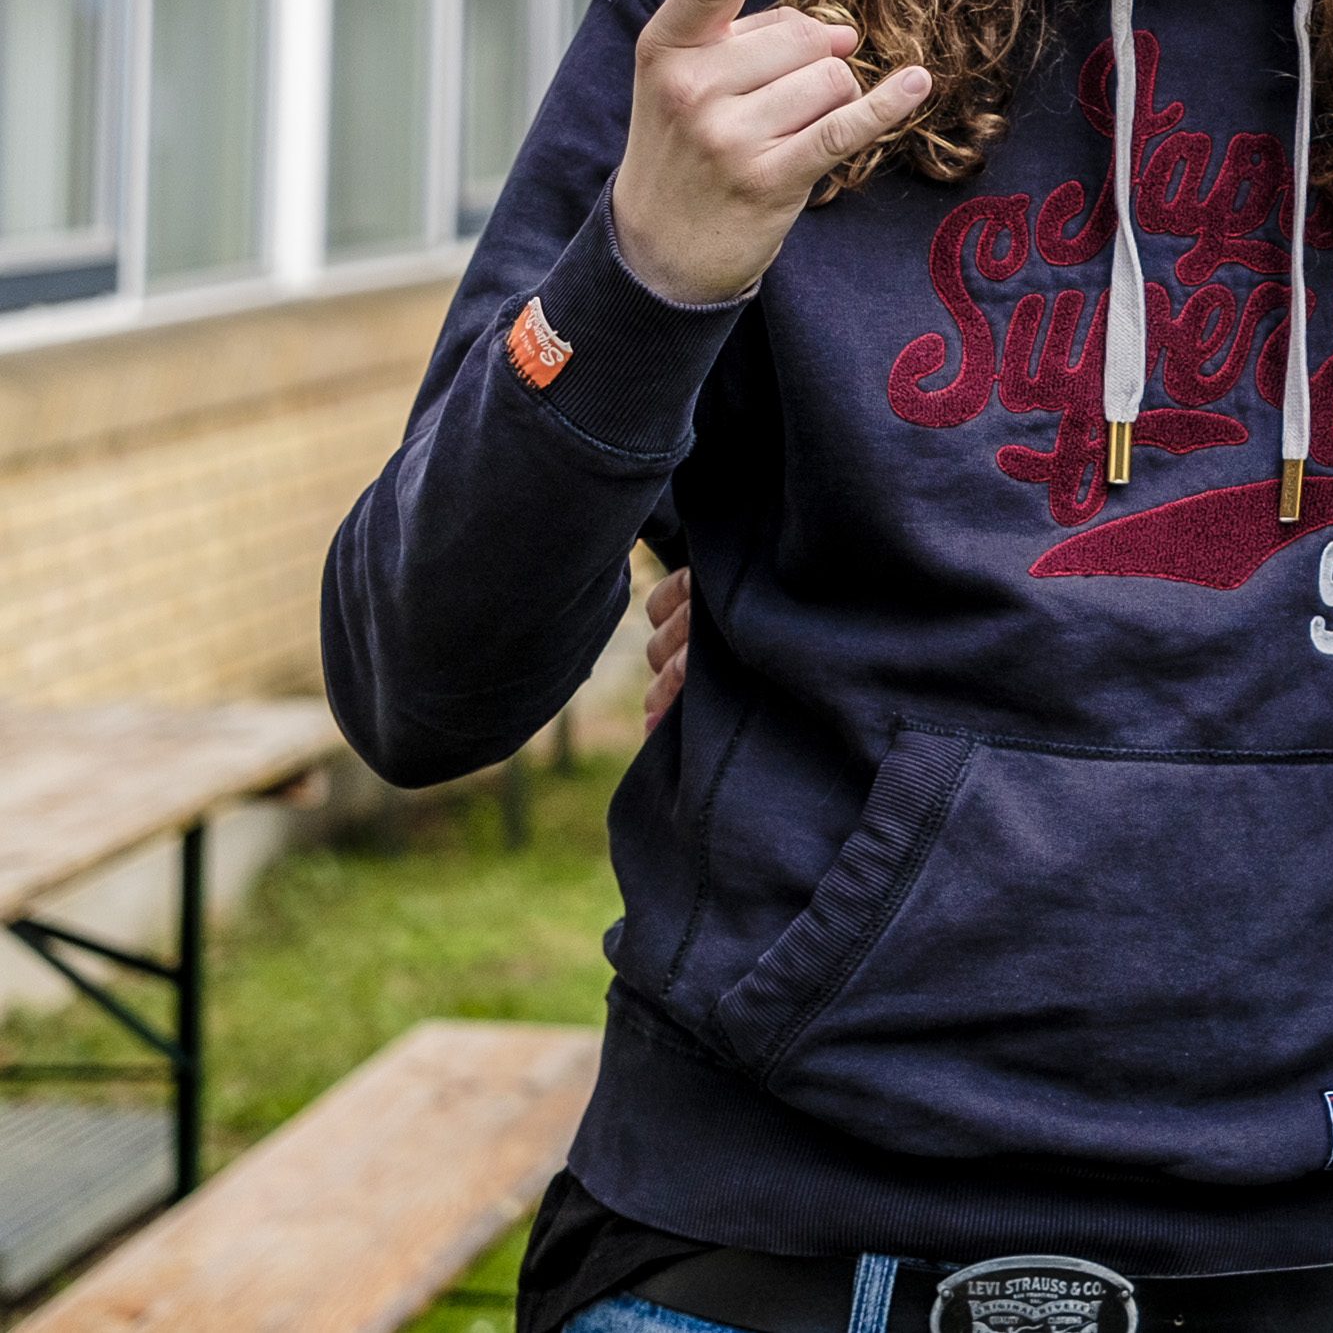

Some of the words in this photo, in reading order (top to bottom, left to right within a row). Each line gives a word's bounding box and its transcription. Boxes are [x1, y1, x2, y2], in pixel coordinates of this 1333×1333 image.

[968, 1280, 1001, 1296] LEVI
[1005, 1276, 1068, 1295] STRAUSS
[1070, 1281, 1081, 1296] &
[1083, 1281, 1107, 1296] CO.
